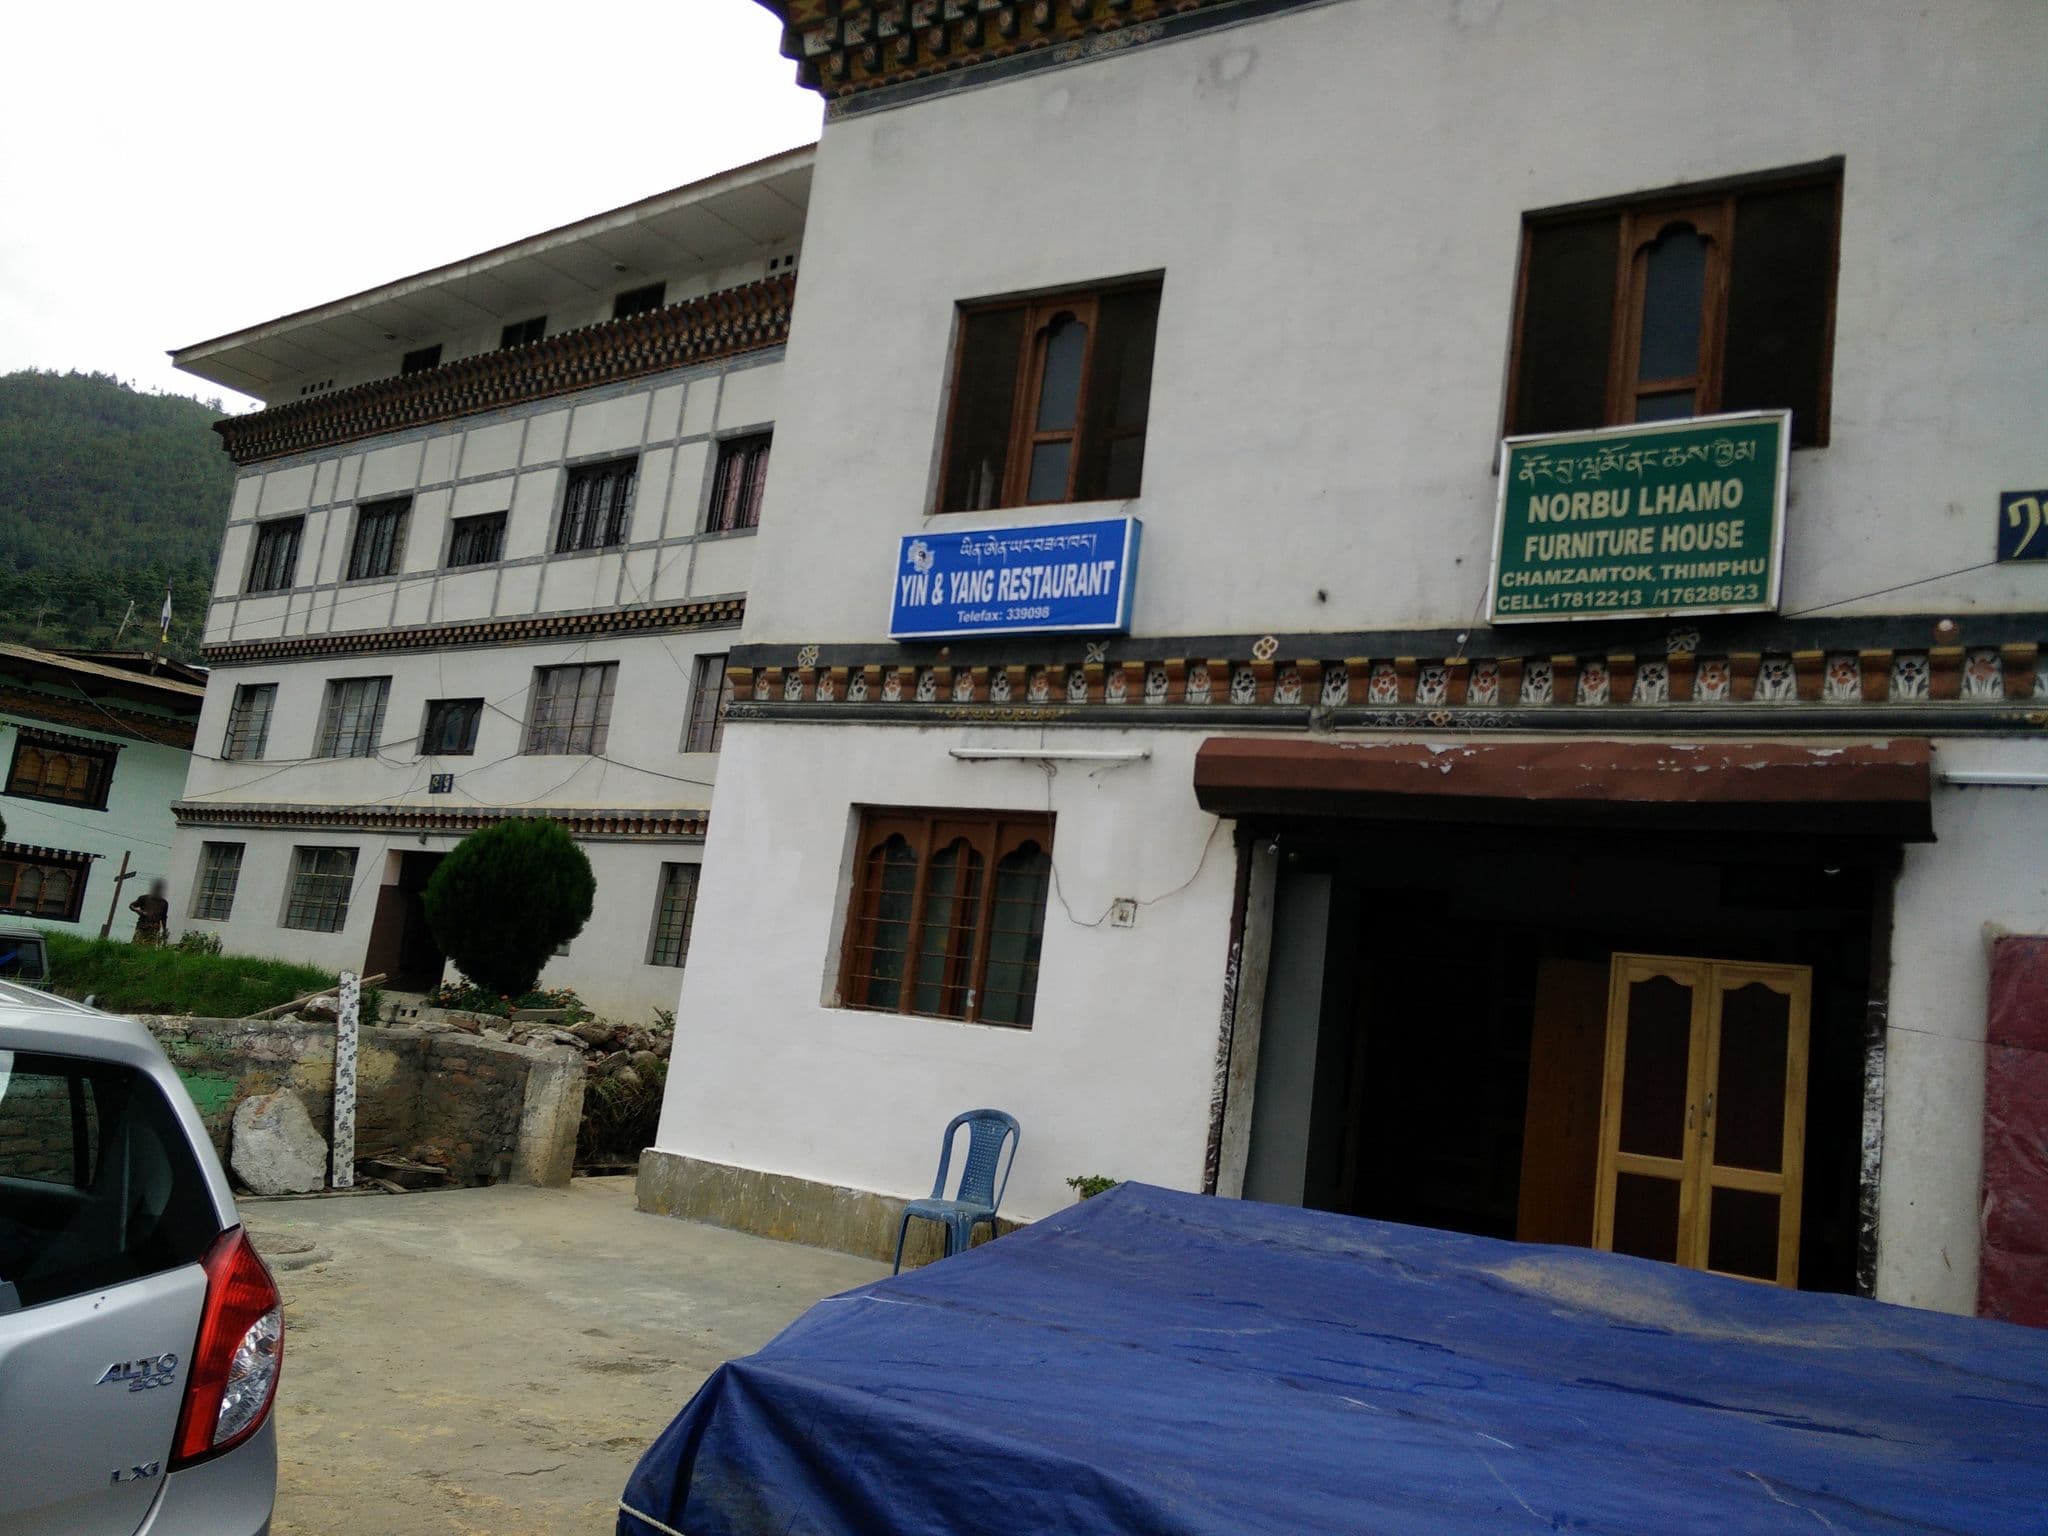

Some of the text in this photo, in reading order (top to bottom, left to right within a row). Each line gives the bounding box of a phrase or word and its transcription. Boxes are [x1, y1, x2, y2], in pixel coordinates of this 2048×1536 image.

[1528, 478, 1744, 523] NORBU LHAMO
[1524, 520, 1745, 563] FURNITURE HOUSE
[901, 560, 1116, 607] YIN & YANG RESTAURANT
[1660, 557, 1766, 581] THIMPHU
[957, 610, 1003, 623] Telefax:
[94, 1353, 178, 1385] ALTO
